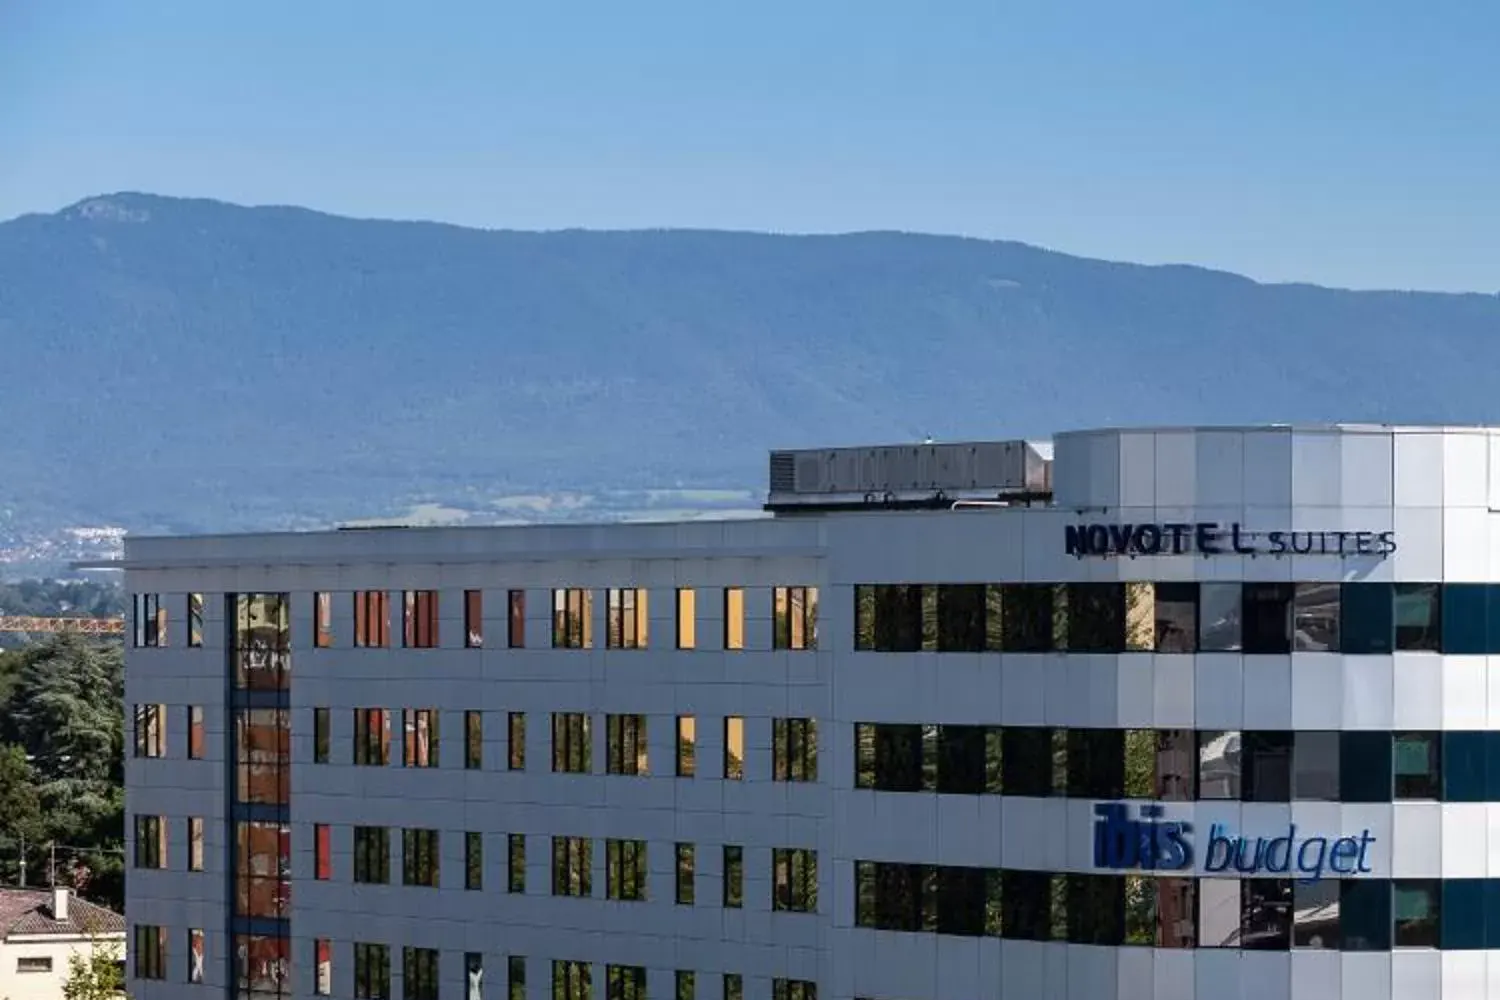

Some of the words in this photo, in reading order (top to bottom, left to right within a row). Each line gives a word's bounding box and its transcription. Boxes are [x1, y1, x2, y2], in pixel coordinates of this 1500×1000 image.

[1064, 522, 1255, 555] NOVOTEL
[1267, 530, 1397, 554] SUITES
[1094, 803, 1196, 870] ibis
[1204, 822, 1376, 886] budget
